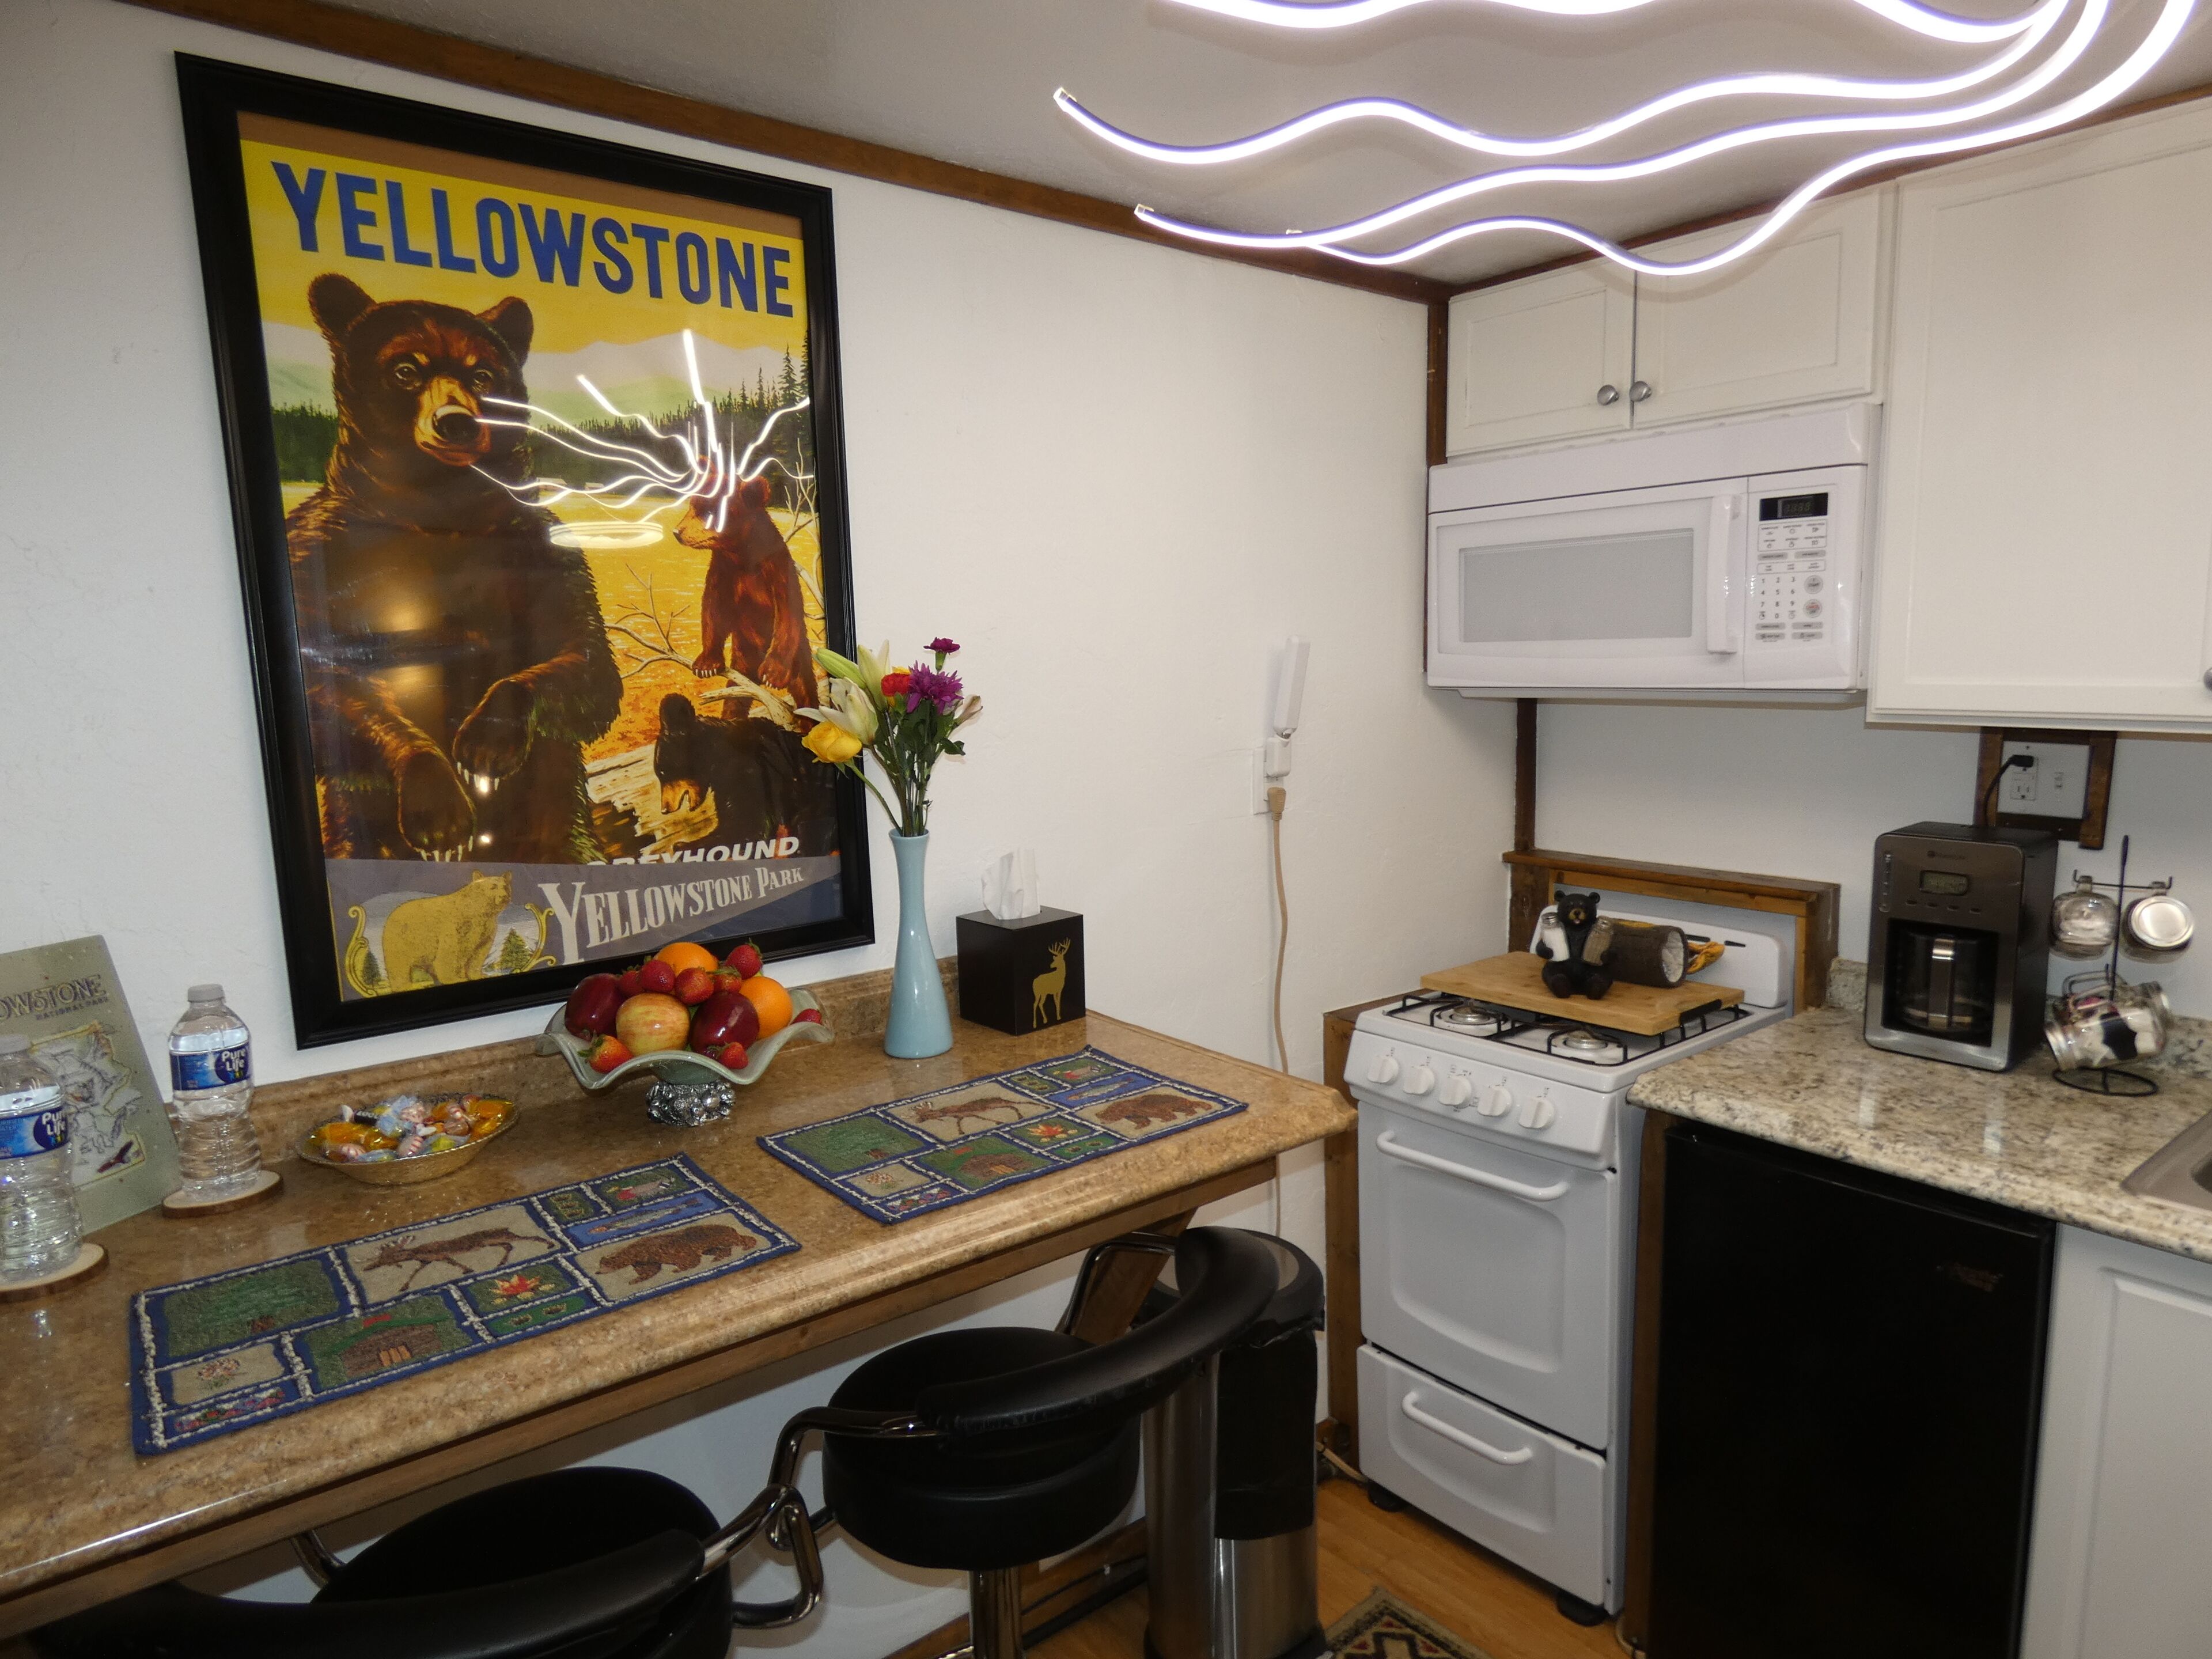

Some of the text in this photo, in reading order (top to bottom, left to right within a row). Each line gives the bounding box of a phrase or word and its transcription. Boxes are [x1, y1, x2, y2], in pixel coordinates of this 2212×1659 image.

[270, 161, 794, 319] YELLOWSTONE
[222, 1048, 246, 1062] Pure
[225, 1059, 245, 1072] Life
